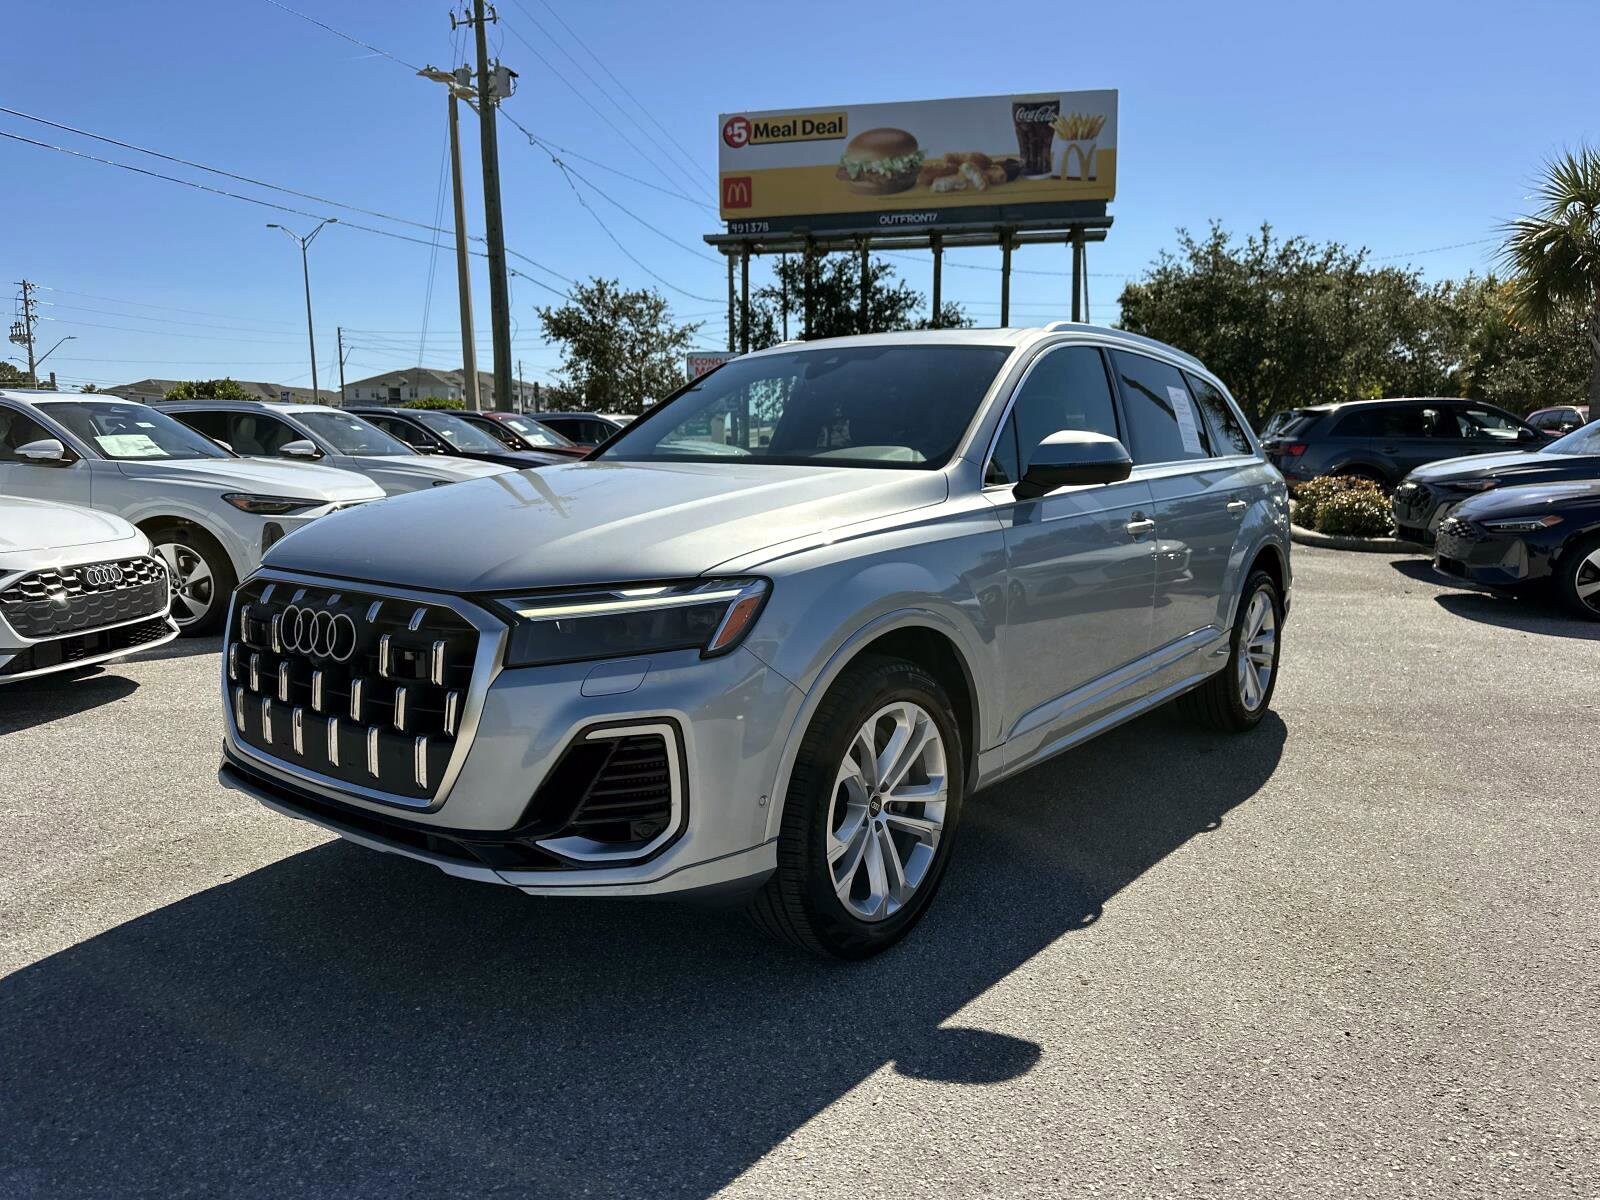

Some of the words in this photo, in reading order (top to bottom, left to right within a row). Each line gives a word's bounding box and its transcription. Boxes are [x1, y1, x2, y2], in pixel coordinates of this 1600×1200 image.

[727, 122, 747, 143] $5
[753, 120, 796, 139] Meal
[802, 116, 843, 136] Deal
